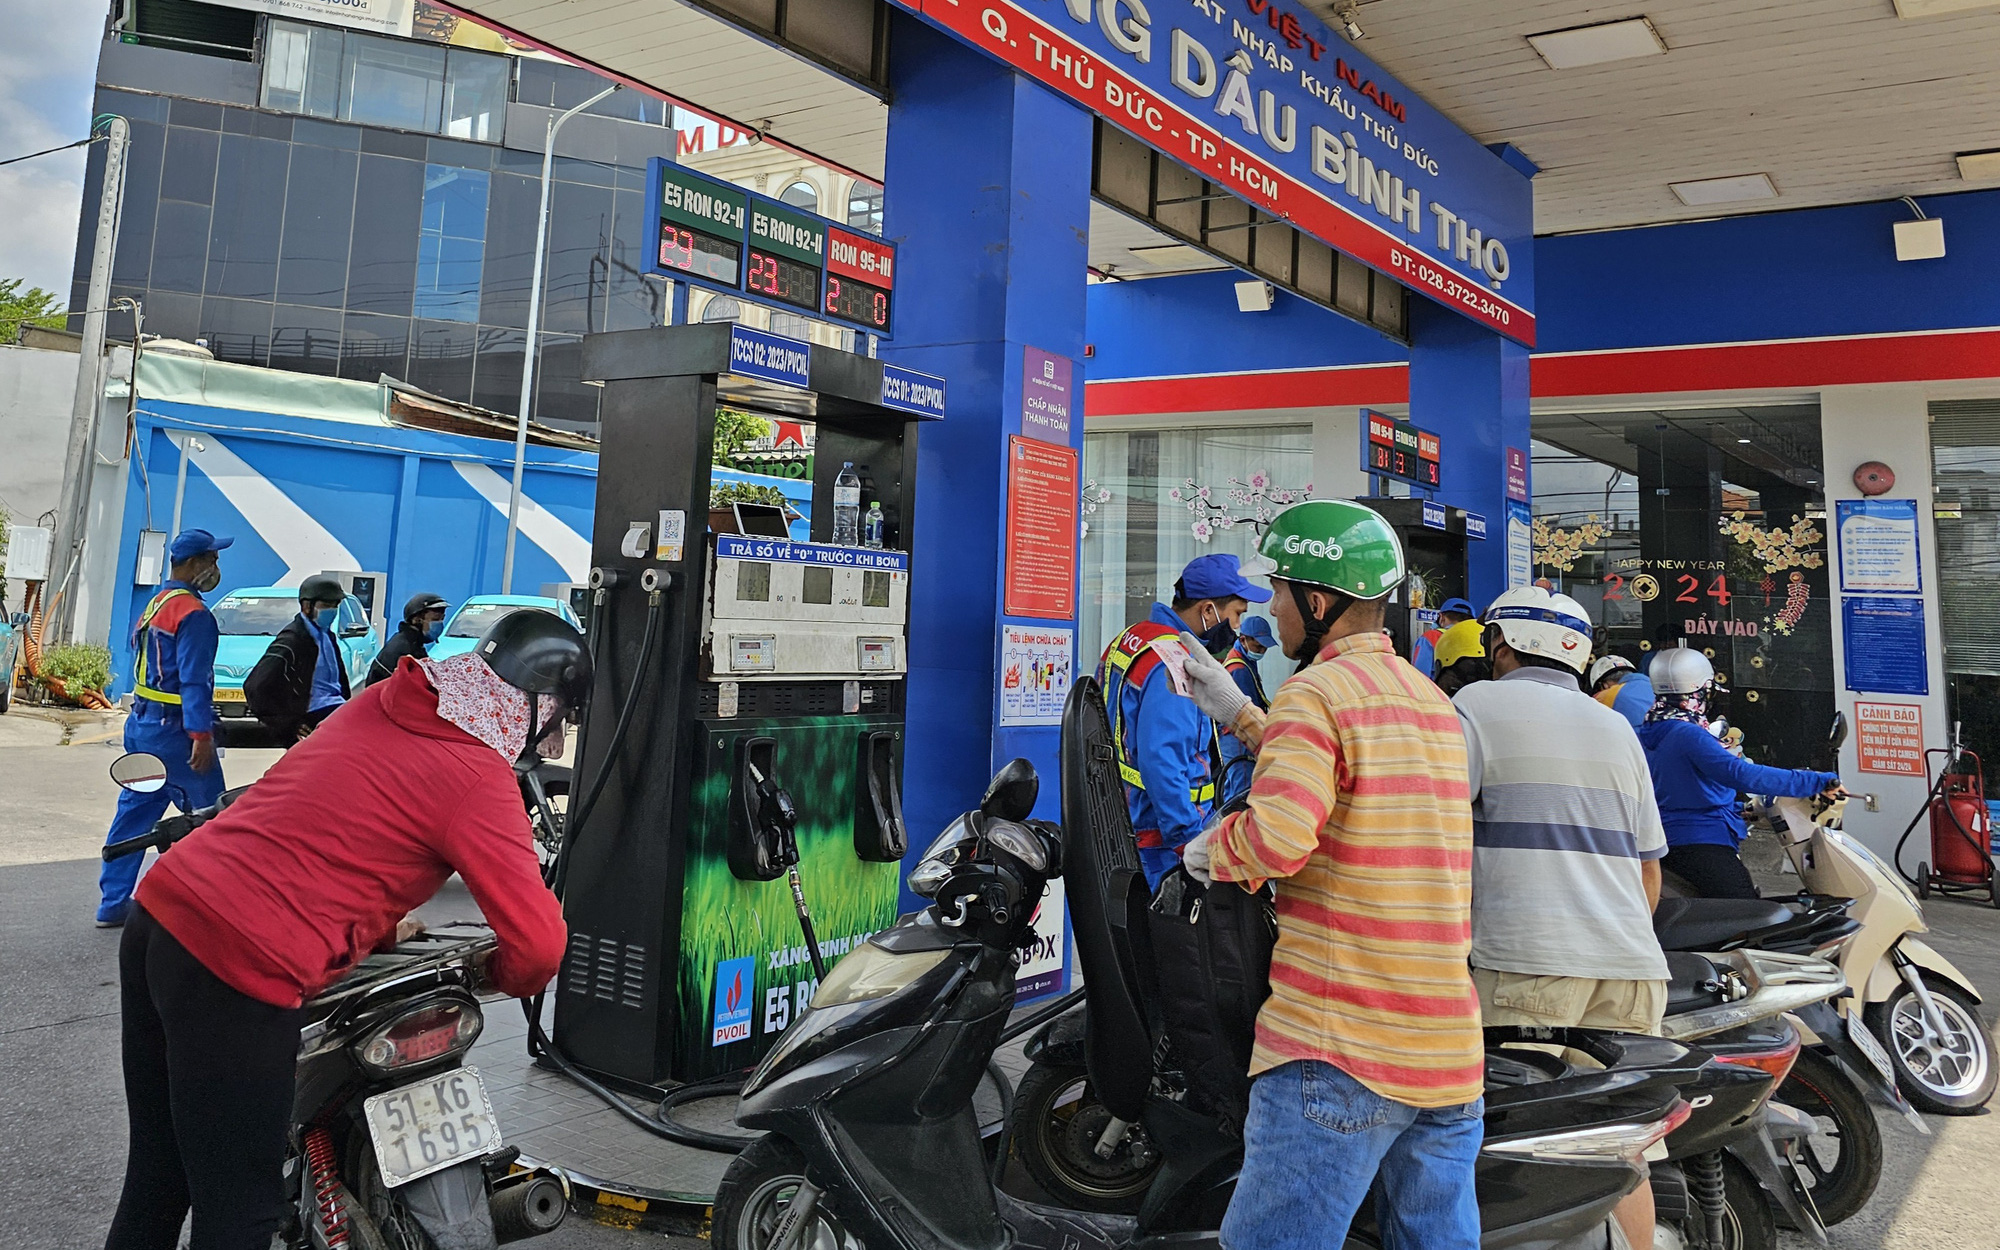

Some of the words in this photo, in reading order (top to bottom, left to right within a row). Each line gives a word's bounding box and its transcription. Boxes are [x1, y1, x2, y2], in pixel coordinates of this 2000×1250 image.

[982, 8, 1017, 47] Q.
[1029, 33, 1094, 90] THỦ
[1105, 80, 1163, 131] ĐỨC
[1230, 157, 1279, 201] HCM
[1233, 18, 1294, 73] NHẬP
[1301, 71, 1356, 120] KHẨU
[1361, 112, 1398, 149] THỦ
[1403, 140, 1439, 177] ĐỨC
[1336, 58, 1406, 123] NAM
[1171, 28, 1297, 154] DẦU
[1311, 124, 1420, 234] BÌNH
[1430, 201, 1510, 290] THỌ
[664, 181, 681, 205] E5
[684, 187, 711, 218] RON
[714, 199, 745, 229] 92-II
[752, 212, 768, 236] E5
[770, 217, 794, 245] RON
[796, 227, 823, 254] 92-II
[831, 240, 856, 266] RON
[860, 250, 892, 278] 95-III
[1391, 249, 1416, 277] ĐT:
[1418, 265, 1510, 325] 028.3722.3470
[733, 337, 754, 362] TCCS
[767, 348, 808, 376] 2023/PVOIL
[883, 375, 900, 398] TCCS
[911, 383, 943, 411] 2023/PVOIL
[1028, 397, 1047, 410] CHẤP
[1048, 404, 1067, 418] NHẬN
[1025, 411, 1048, 427] THANH
[1050, 418, 1068, 432] TOÁN
[730, 541, 753, 557] TRẢ
[756, 543, 774, 558] SỐ
[777, 543, 791, 559] VỀ
[815, 550, 853, 564] TRƯỚC
[855, 553, 874, 566] KHI
[876, 556, 900, 568] BƠM
[1284, 534, 1343, 561] Grab
[1612, 559, 1651, 570] HAPPY
[1657, 560, 1686, 570] NEW
[1690, 560, 1726, 571] YEAR
[1684, 612, 1718, 636] ĐẨY
[1724, 618, 1758, 637] VÀO
[1862, 705, 1891, 719] CẢNH
[1894, 708, 1915, 721] BÁO
[818, 936, 850, 959] SINH
[764, 985, 790, 1034] E5
[716, 1023, 748, 1042] PVOIL
[390, 1113, 482, 1170] 1695
